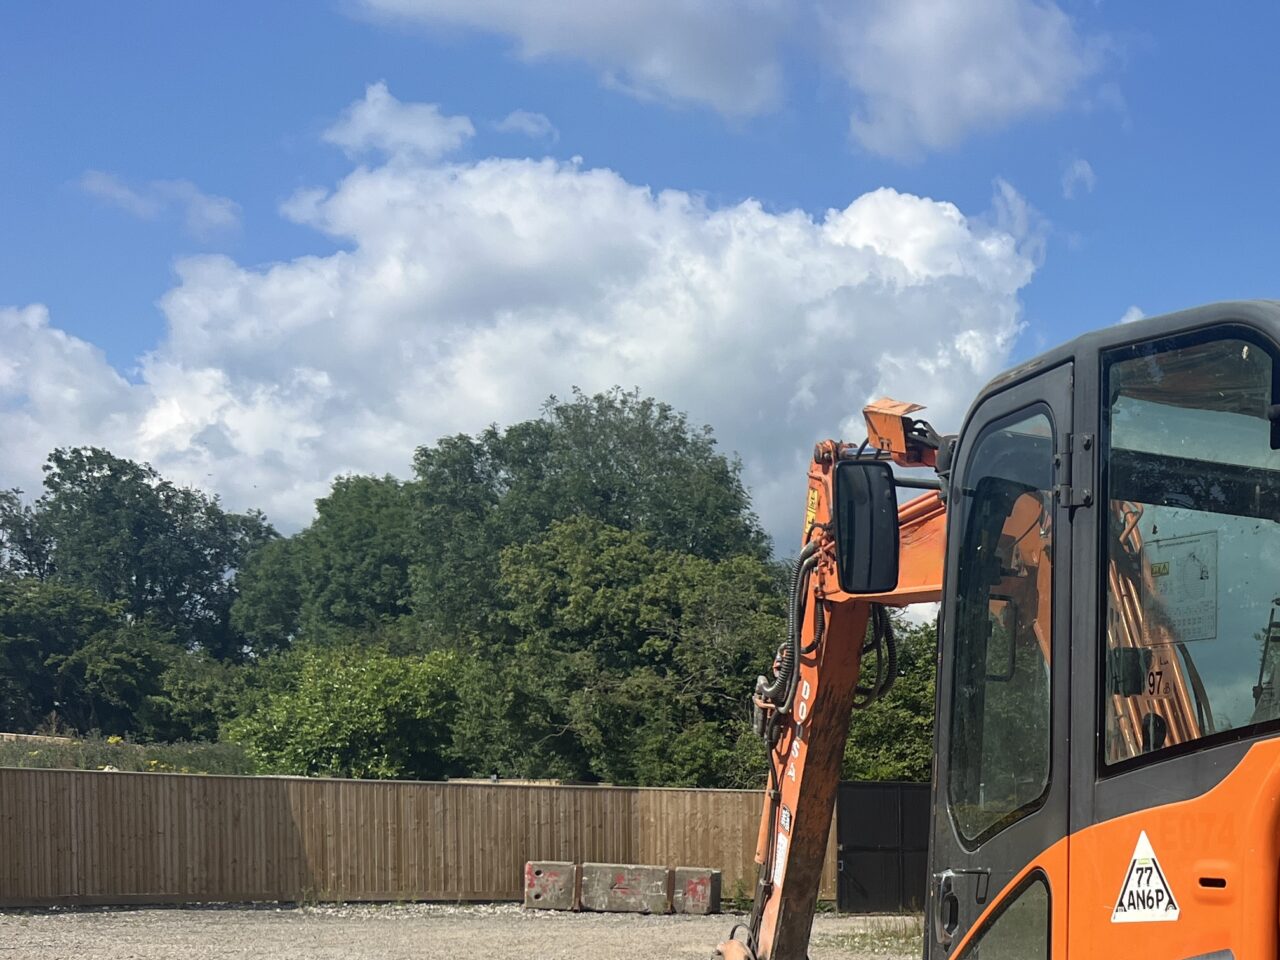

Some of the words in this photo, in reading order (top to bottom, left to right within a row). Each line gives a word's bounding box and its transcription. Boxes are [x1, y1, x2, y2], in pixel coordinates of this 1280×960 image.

[1148, 671, 1163, 695] 97
[1135, 866, 1153, 887] 77
[1127, 889, 1164, 910] AN6P
